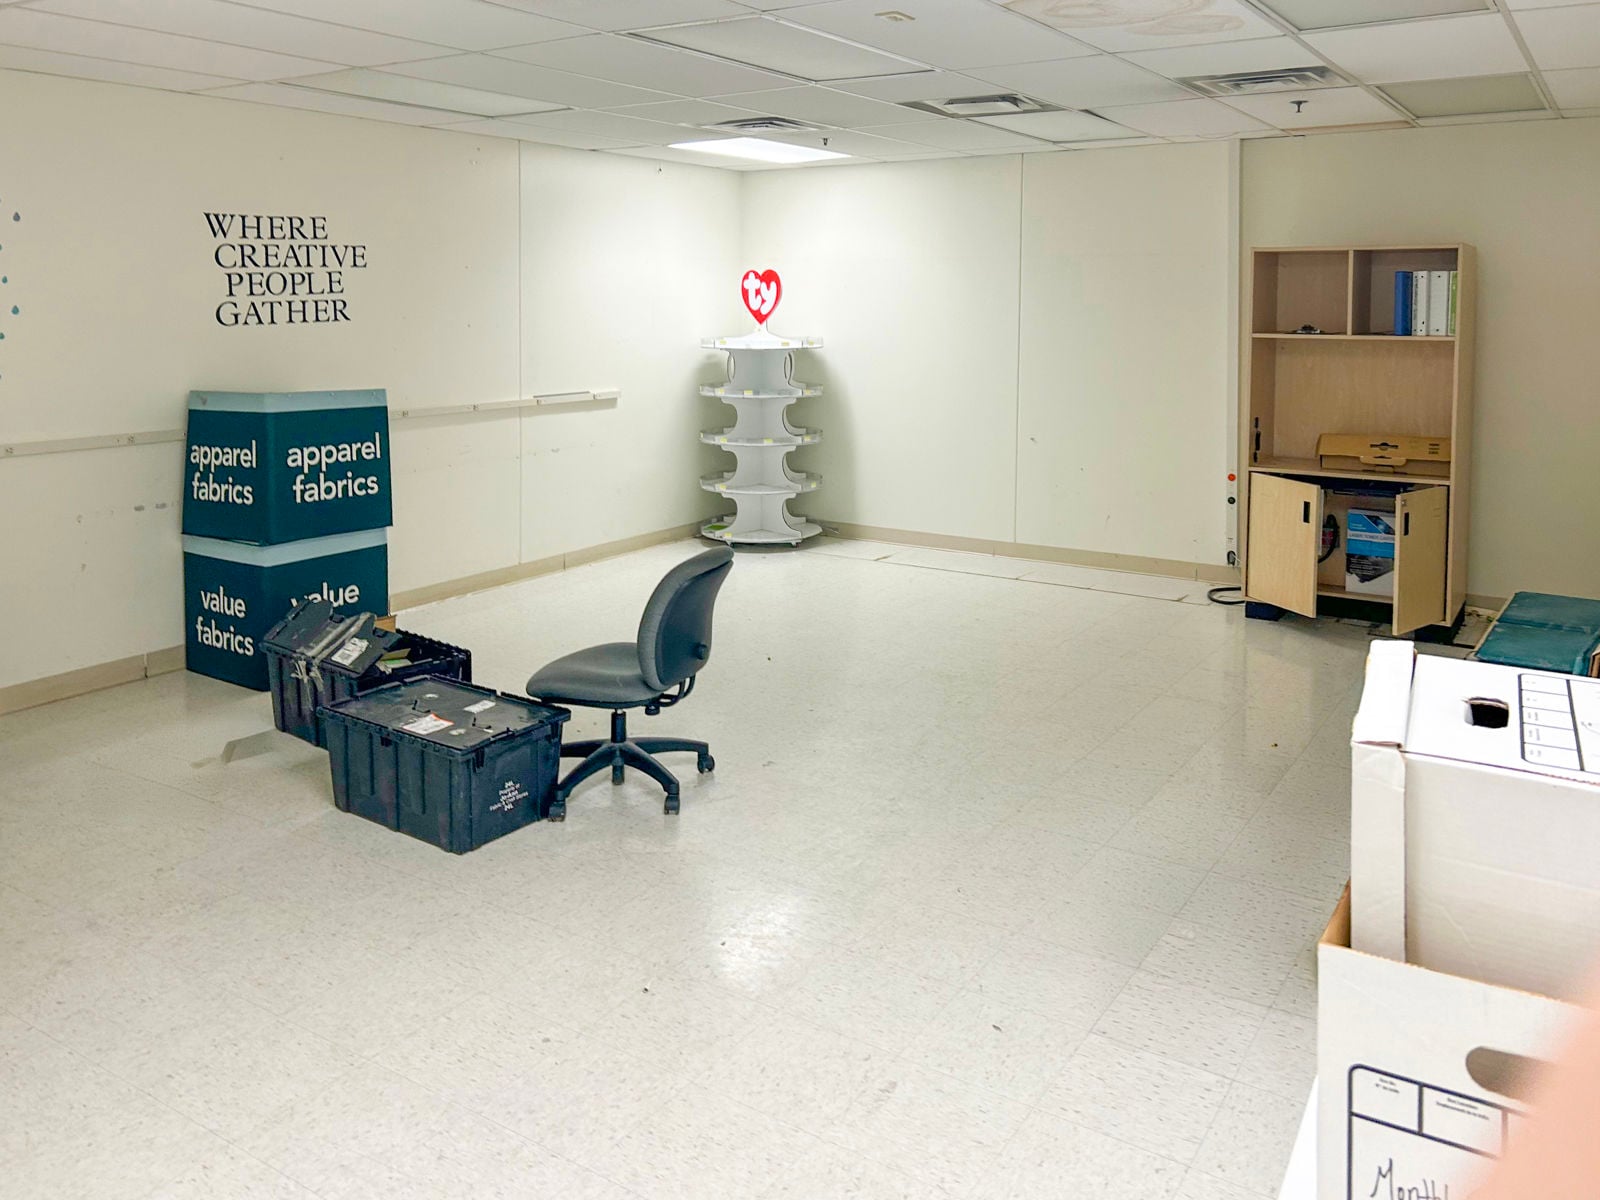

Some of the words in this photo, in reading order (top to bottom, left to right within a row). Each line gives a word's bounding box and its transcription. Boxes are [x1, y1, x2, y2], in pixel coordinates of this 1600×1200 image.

[203, 212, 328, 240] WHERE
[214, 243, 368, 269] CREATIVE
[224, 271, 344, 297] PEOPLE
[743, 271, 778, 315] ty
[215, 299, 351, 327] GATHER
[190, 440, 257, 473] apparel
[286, 432, 381, 474] apparel
[191, 472, 254, 505] fabrics
[292, 472, 379, 504] fabrics
[200, 586, 246, 618] value
[196, 616, 254, 656] fabrics
